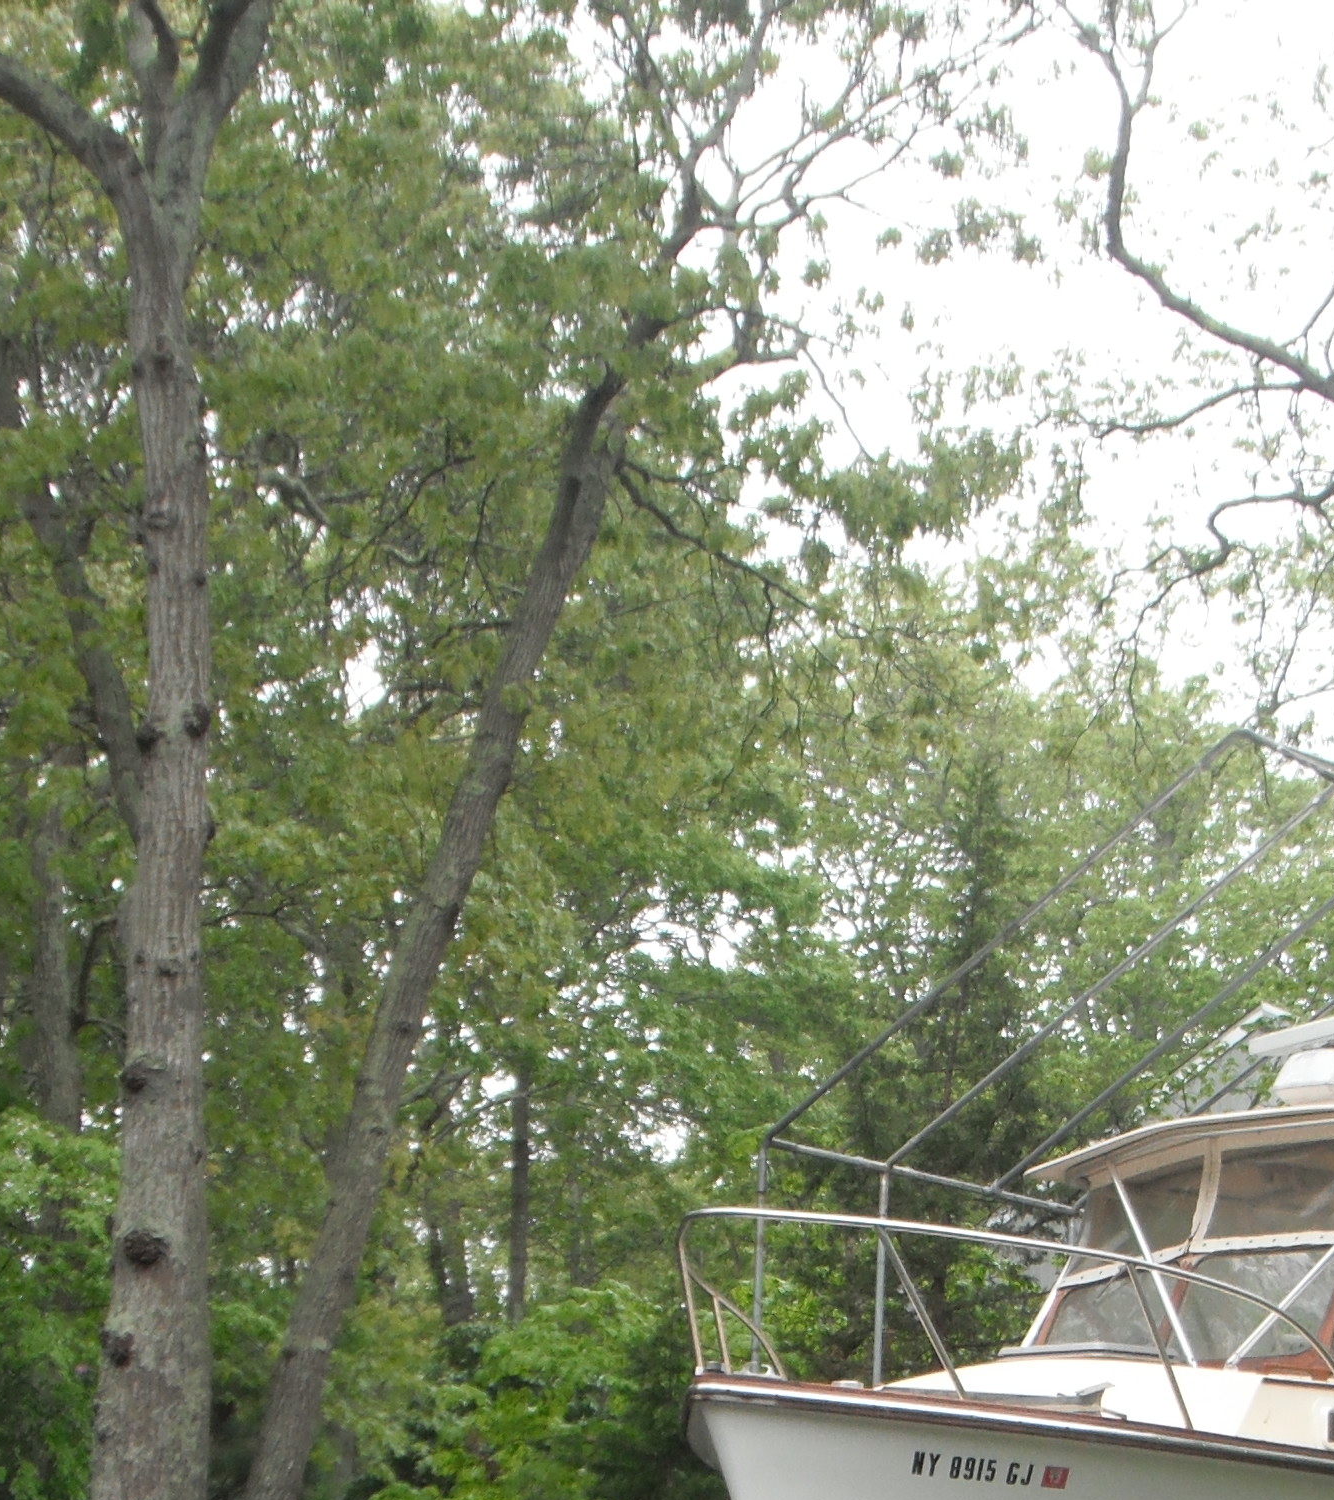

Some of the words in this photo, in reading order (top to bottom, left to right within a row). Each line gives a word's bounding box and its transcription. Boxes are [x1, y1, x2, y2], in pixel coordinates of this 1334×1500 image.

[911, 1450, 942, 1477] NY
[949, 1456, 998, 1483] 8915
[1005, 1462, 1035, 1486] GJ
